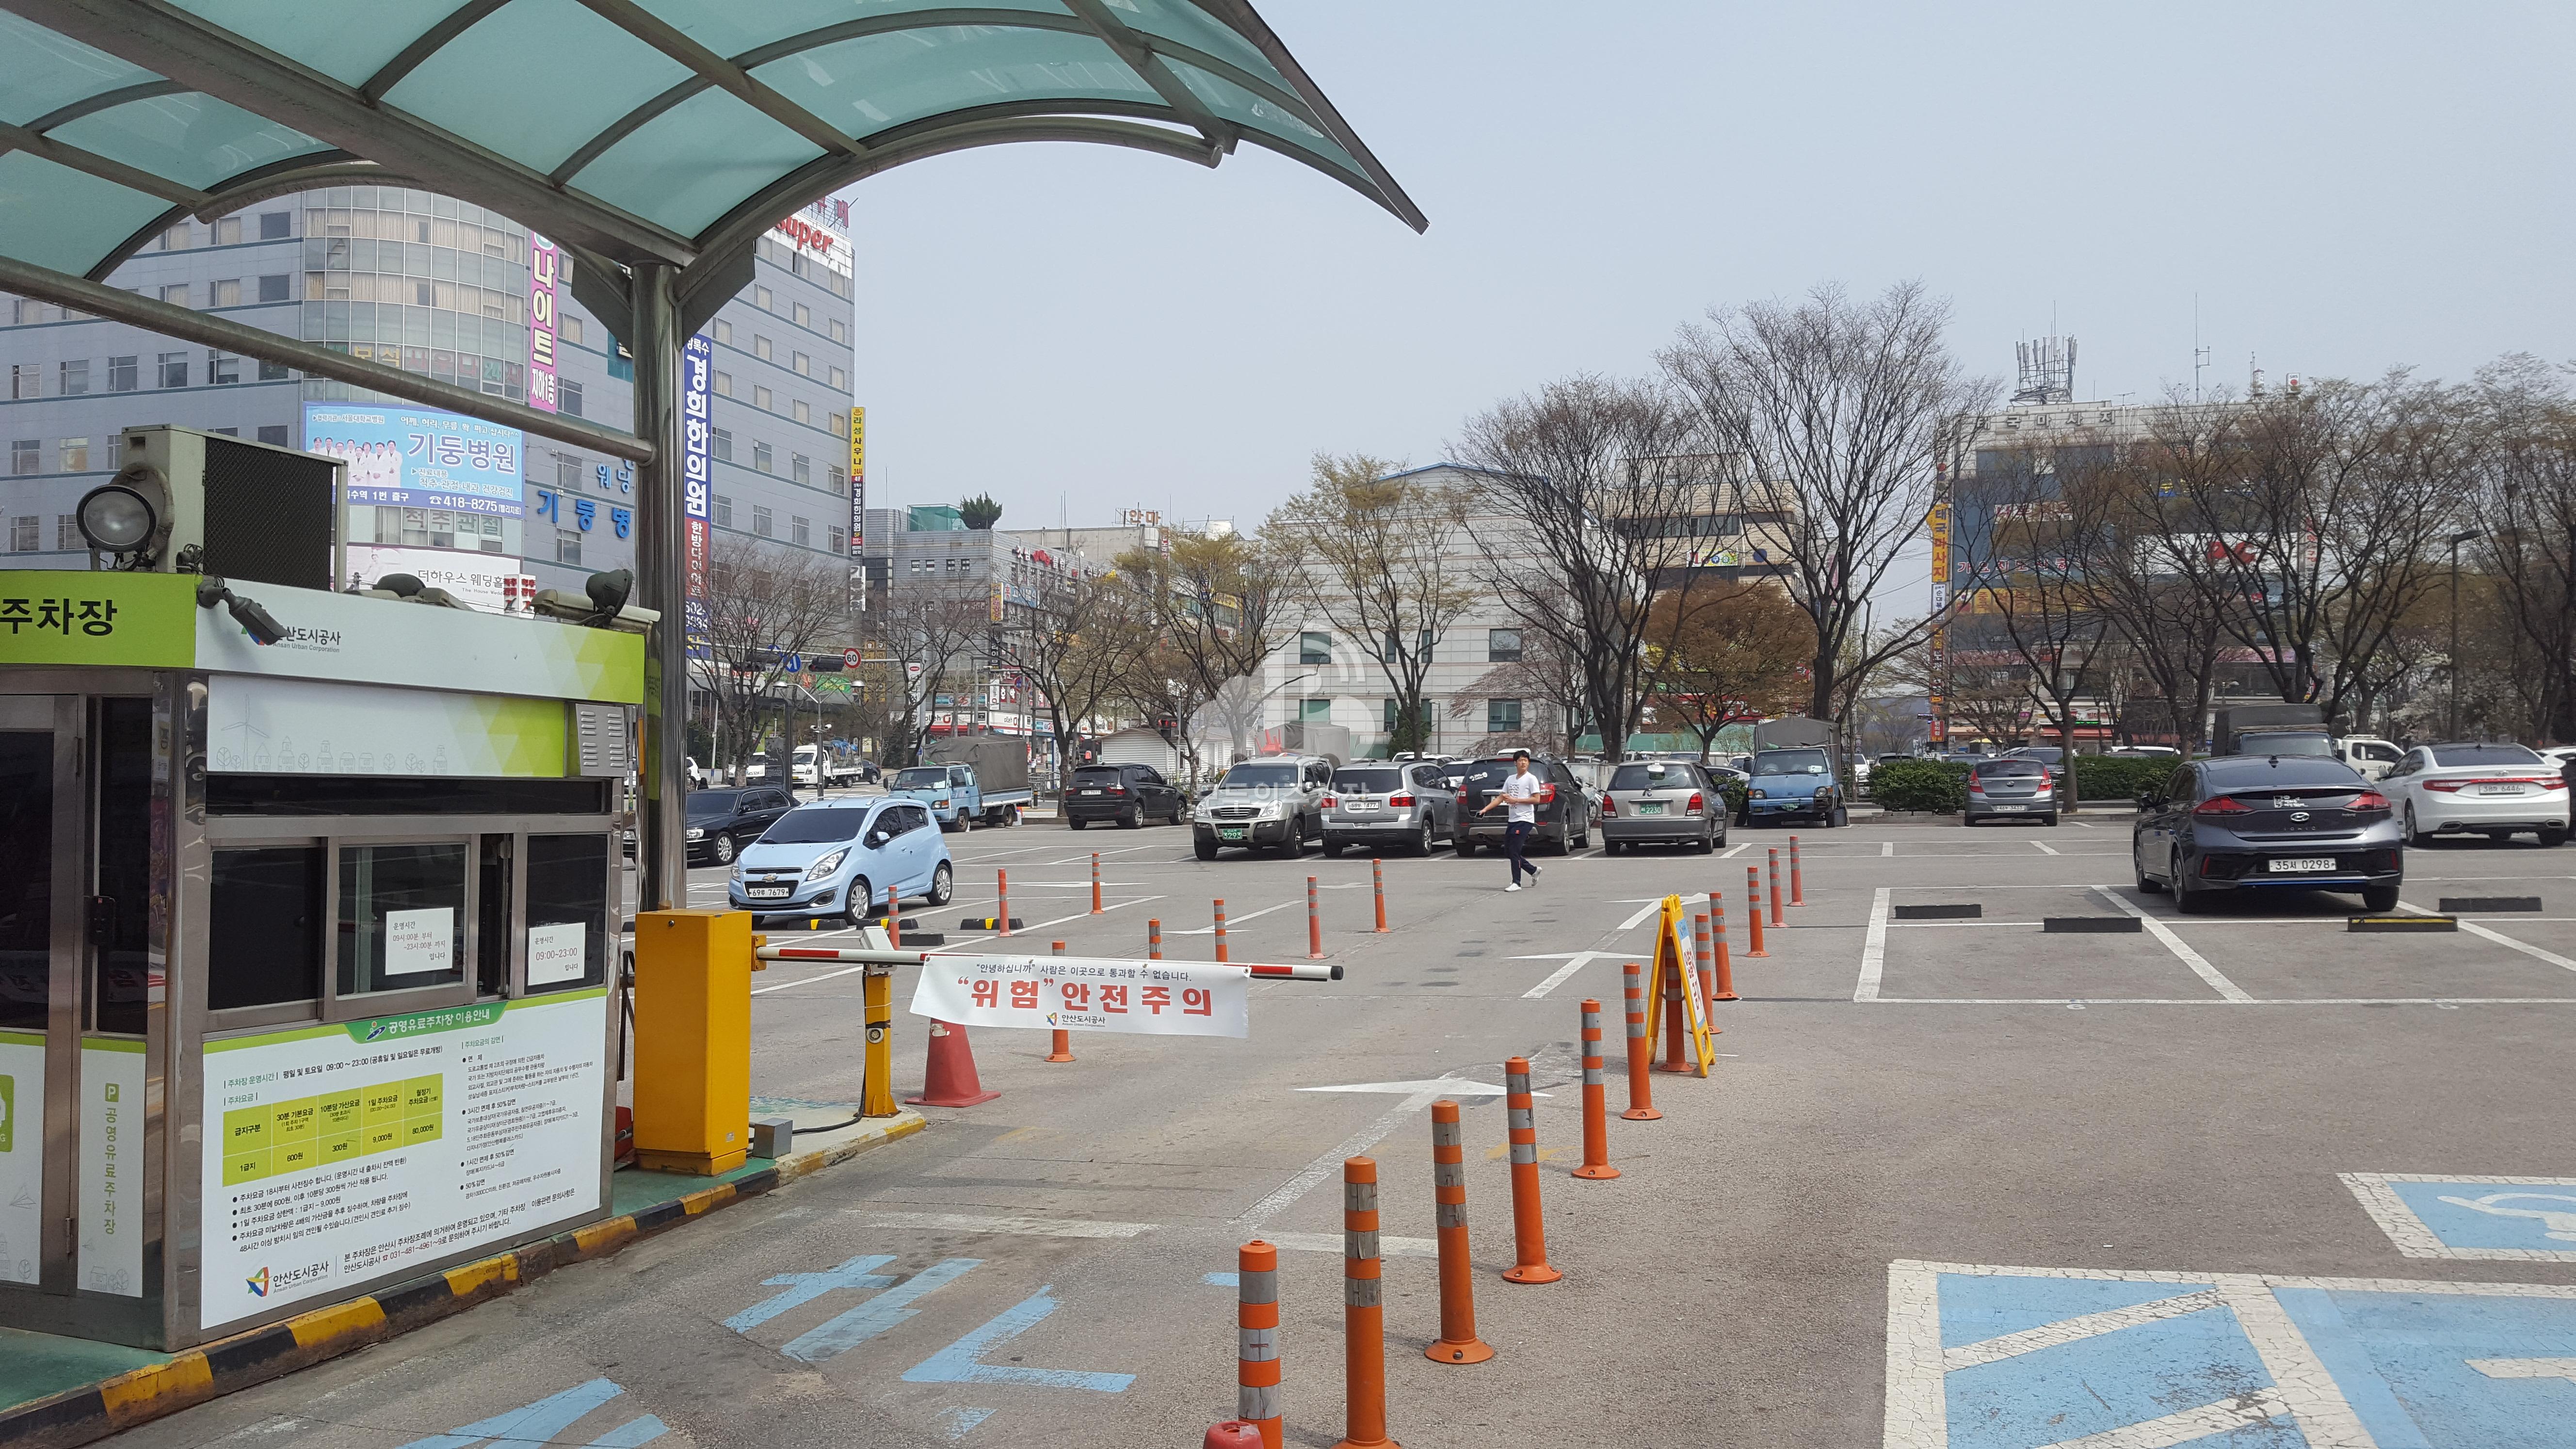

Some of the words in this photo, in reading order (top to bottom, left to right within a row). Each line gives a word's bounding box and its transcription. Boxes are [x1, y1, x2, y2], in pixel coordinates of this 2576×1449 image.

[533, 254, 554, 366] 나이트
[531, 367, 555, 405] 지하1층
[342, 415, 384, 423] 서울대학교병원
[421, 419, 440, 429] 허리,
[686, 354, 708, 518] 경희한의원
[408, 433, 515, 473] 기둥병원
[419, 468, 448, 478] 진료내용
[373, 490, 387, 500] 1번
[392, 491, 409, 501] 출구
[483, 484, 513, 497] 건강검진
[444, 496, 497, 511] 418-8275
[853, 488, 862, 531] 경희한의원
[418, 570, 467, 583] 더하우스
[470, 574, 503, 588] 웨딩홀
[0, 597, 118, 636] 주차장
[279, 626, 341, 645] 산도시공사
[309, 644, 340, 653] Corporation
[847, 654, 857, 662] 60
[2275, 860, 2297, 870] 35서
[2302, 859, 2330, 869] 0298
[393, 921, 416, 931] 운영시간
[421, 932, 433, 940] 부터
[534, 935, 554, 945] 운영시간
[435, 940, 446, 948] 까지
[429, 951, 446, 961] 입니다
[535, 947, 578, 961] 09:00~23:00
[564, 963, 579, 971] 입니다
[1040, 966, 1066, 976] 사람은
[1070, 966, 1104, 977] 이곳으로
[1109, 968, 1135, 979] 통과할
[1139, 969, 1148, 979] 수
[1153, 970, 1192, 982] 없습니다.
[388, 1013, 454, 1034] 공영유료주차장
[455, 1008, 490, 1024] 이용안내
[1062, 1014, 1106, 1024] 안산도시공사
[282, 1068, 295, 1079] 평일
[296, 1067, 303, 1077] 및
[304, 1064, 323, 1075] 토요일
[325, 1061, 344, 1072] 09:00
[351, 1057, 369, 1067] 23:00
[369, 1053, 389, 1065] (공휴일
[389, 1052, 396, 1062] 및
[397, 1049, 419, 1060] 일요일은
[419, 1045, 443, 1056] 무료개방)
[227, 1076, 248, 1088] 주차장
[248, 1072, 275, 1085] 운영시간
[227, 1093, 254, 1105] 주차요금
[416, 1087, 431, 1097] 월정기
[320, 1102, 338, 1113] 10분당
[338, 1098, 360, 1110] 가산요금
[368, 1098, 377, 1107] 1일
[376, 1094, 399, 1106] 주차요금
[408, 1095, 429, 1107] 주차요금
[276, 1111, 290, 1122] 30분
[290, 1107, 314, 1119] 기본요금
[234, 1123, 261, 1137] 급지구분
[411, 1123, 434, 1135] 80,000원
[372, 1132, 393, 1143] 9,000원
[331, 1142, 348, 1152] 300원
[286, 1151, 304, 1162] 600원
[104, 1107, 117, 1235] 공영유료주차장
[239, 1161, 256, 1172] 1급지
[239, 1189, 265, 1202] 주차요금
[265, 1183, 290, 1196] 18시부터
[290, 1178, 314, 1190] 사전징수
[315, 1173, 334, 1185] 합니다.
[334, 1167, 358, 1180] (운영시간
[358, 1166, 365, 1174] 내
[365, 1162, 382, 1173] 출차시
[383, 1159, 394, 1169] 잔액
[394, 1156, 407, 1166] 반환)
[239, 1205, 253, 1215] 최초
[253, 1199, 273, 1212] 30분에
[274, 1195, 292, 1207] 600원,
[293, 1192, 306, 1202] 이후
[306, 1187, 324, 1199] 10분당
[324, 1182, 346, 1194] 300원씩
[346, 1179, 358, 1189] 가산
[358, 1176, 370, 1186] 적용
[370, 1172, 388, 1183] 됩니다.
[240, 1217, 250, 1227] 1일
[250, 1212, 275, 1225] 주차요금
[275, 1207, 294, 1219] 상한액
[299, 1202, 314, 1213] 1급지
[320, 1195, 341, 1208] 9,000원
[343, 1252, 351, 1263] 본
[351, 1245, 377, 1260] 주차장은
[377, 1239, 397, 1253] 안산시
[397, 1229, 433, 1247] 주차장조례에
[433, 1222, 456, 1236] 의거하여
[456, 1216, 479, 1230] 운영되고
[479, 1210, 498, 1223] 있으며,
[497, 1207, 509, 1217] 기타
[509, 1202, 527, 1214] 주차장
[531, 1194, 551, 1208] 이용관련
[551, 1188, 576, 1202] 문의사항은
[389, 1236, 448, 1260] 031-481-4961~9로
[448, 1228, 470, 1243] 문의하여
[470, 1223, 488, 1236] 주시기
[488, 1216, 511, 1230] 바랍니다.
[343, 1255, 381, 1274] 안산도시공사
[273, 1260, 329, 1288] 안산도시공사
